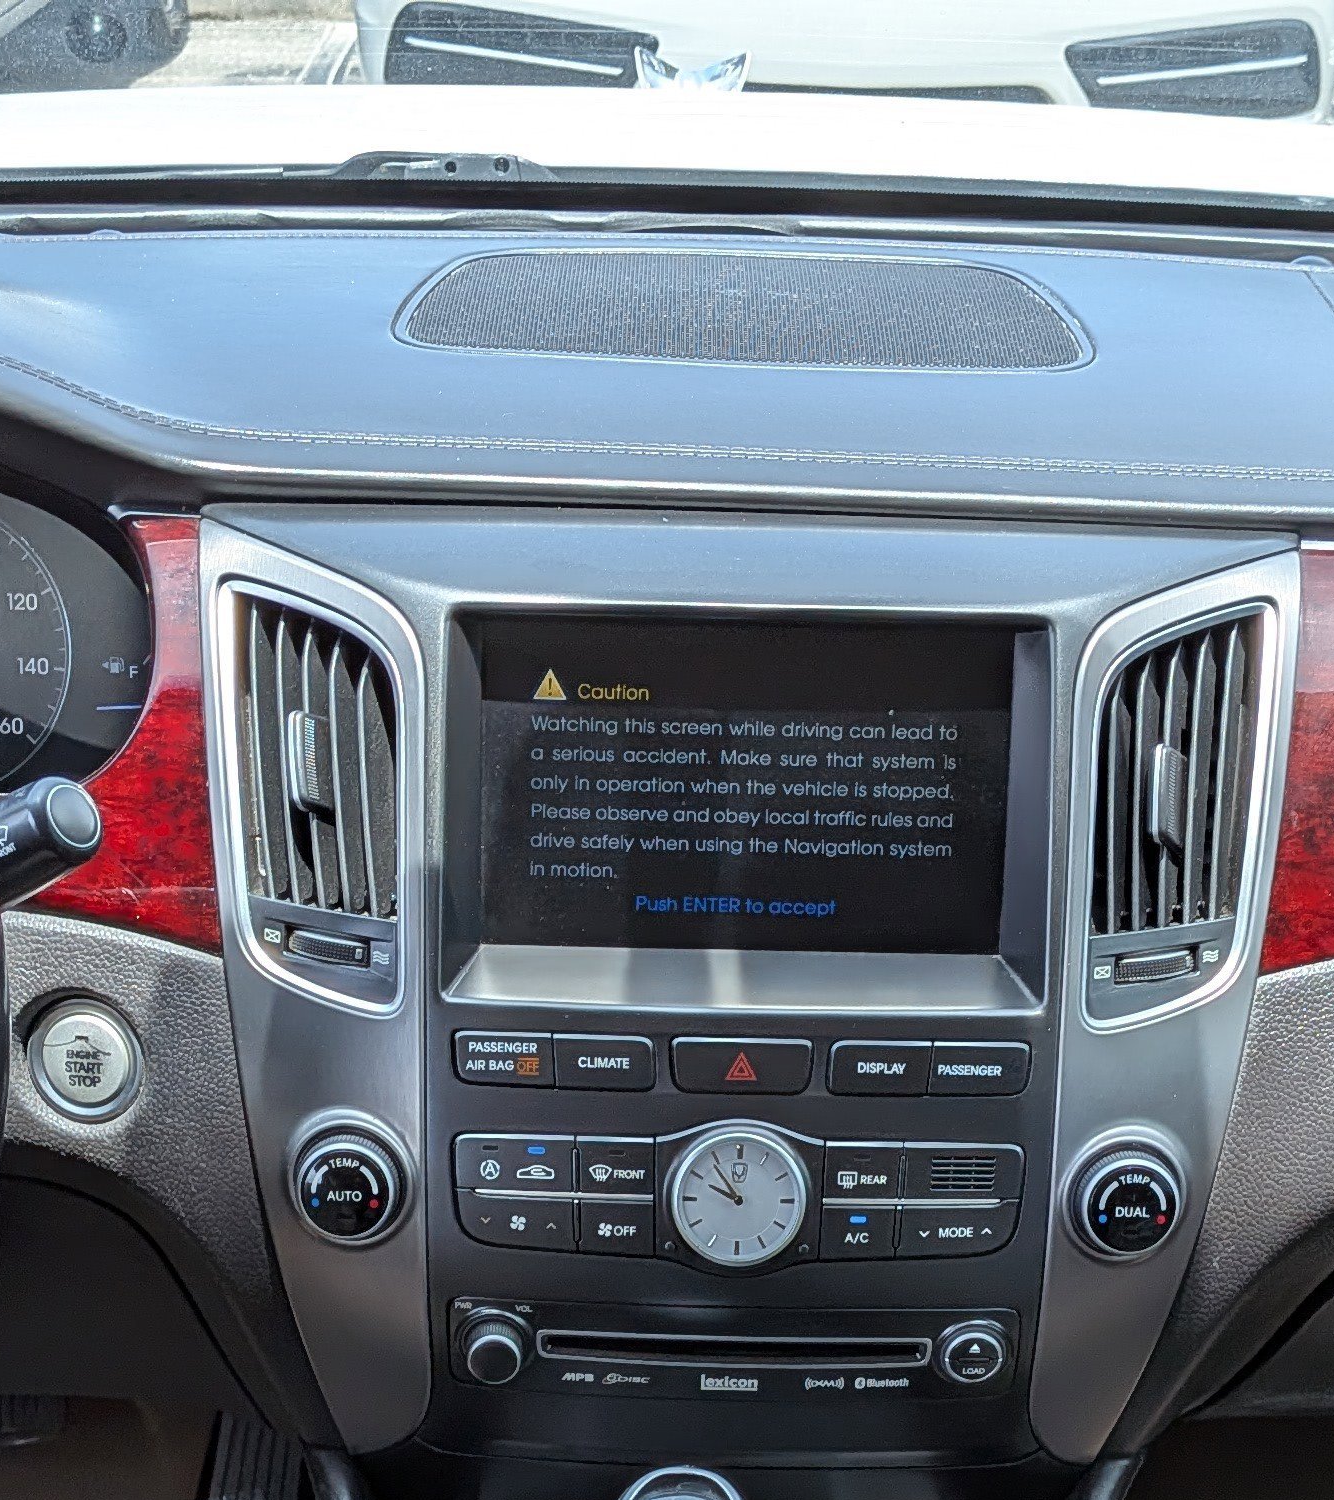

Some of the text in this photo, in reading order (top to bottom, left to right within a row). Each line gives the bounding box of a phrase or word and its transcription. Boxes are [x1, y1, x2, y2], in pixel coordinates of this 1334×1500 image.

[6, 592, 38, 612] 120
[17, 656, 50, 676] 140
[129, 665, 139, 679] F
[577, 683, 650, 702] Caution
[531, 715, 958, 742] Watching this screen while driving can lead to
[530, 745, 957, 772] a serious accident. Make sure that system is
[530, 774, 955, 802] only in operation when the vehicle is stopped.
[531, 803, 954, 831] Please observe and obey local traffic rules and
[529, 832, 952, 860] drive safely when using the Navigation system
[529, 860, 618, 880] in motion.
[635, 895, 837, 918] Push ENTER to accept
[65, 1049, 102, 1061] ENGINE
[467, 1041, 539, 1055] PASSENGER
[64, 1060, 104, 1076] START
[465, 1059, 540, 1074] AIR BAG OFF
[577, 1056, 630, 1070] CLIMATE
[856, 1061, 907, 1075] DISPLAY
[937, 1064, 1003, 1078] PASSENGER
[68, 1074, 102, 1089] STOP
[327, 1156, 361, 1170] TEMP
[613, 1168, 646, 1181] FRONT
[859, 1174, 887, 1186] REAR
[1118, 1173, 1152, 1187] TEMP
[326, 1189, 363, 1203] AUTO
[1114, 1205, 1150, 1219] DUAL
[613, 1225, 637, 1237] OFF
[938, 1226, 974, 1239] MODE
[844, 1232, 869, 1245] A/C
